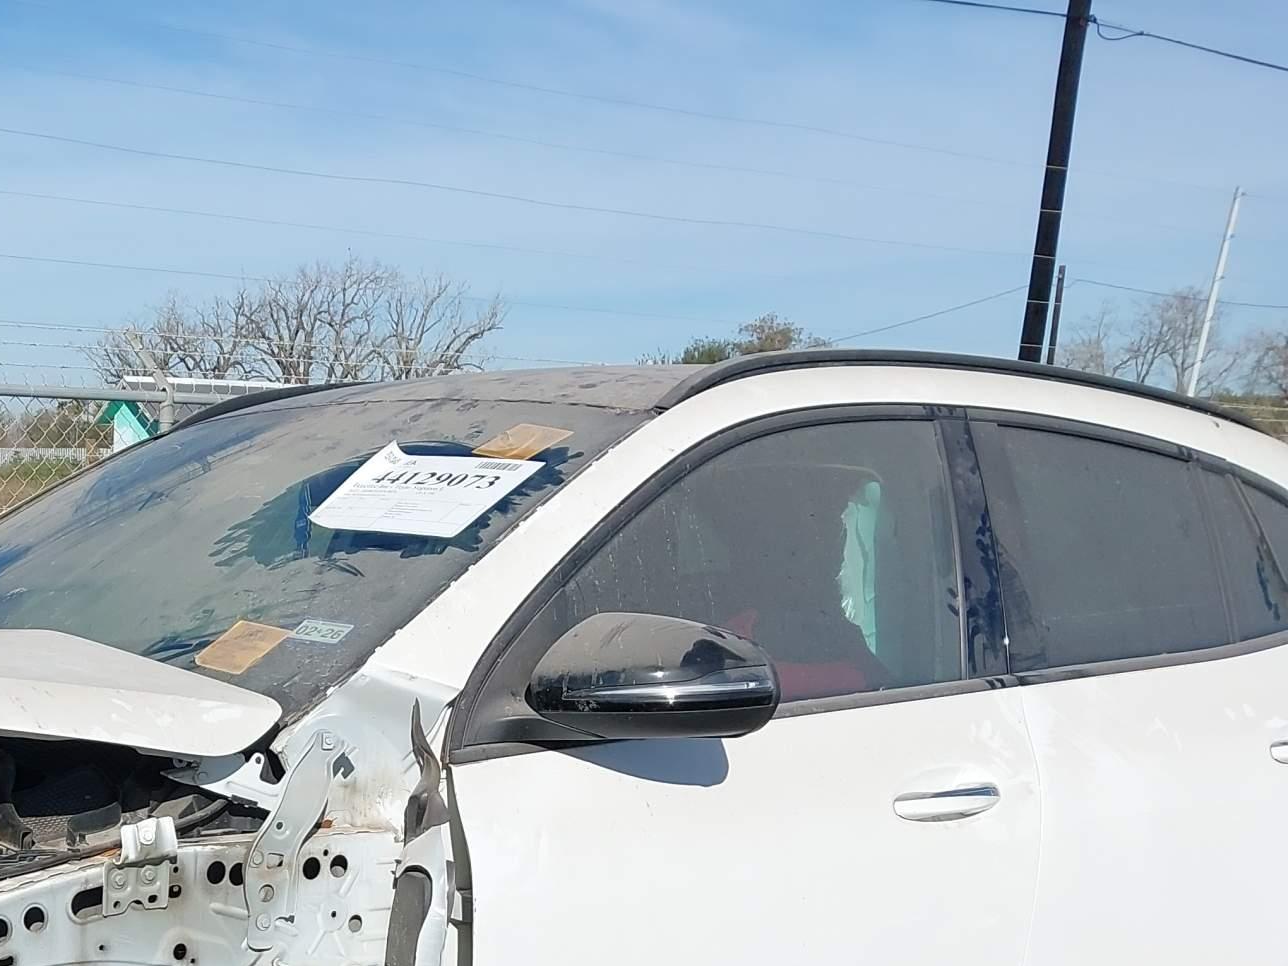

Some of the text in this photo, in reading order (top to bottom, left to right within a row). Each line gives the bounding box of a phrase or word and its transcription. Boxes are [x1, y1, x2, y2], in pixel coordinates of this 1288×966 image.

[372, 470, 502, 490] 44129073
[296, 624, 344, 641] 02 26
